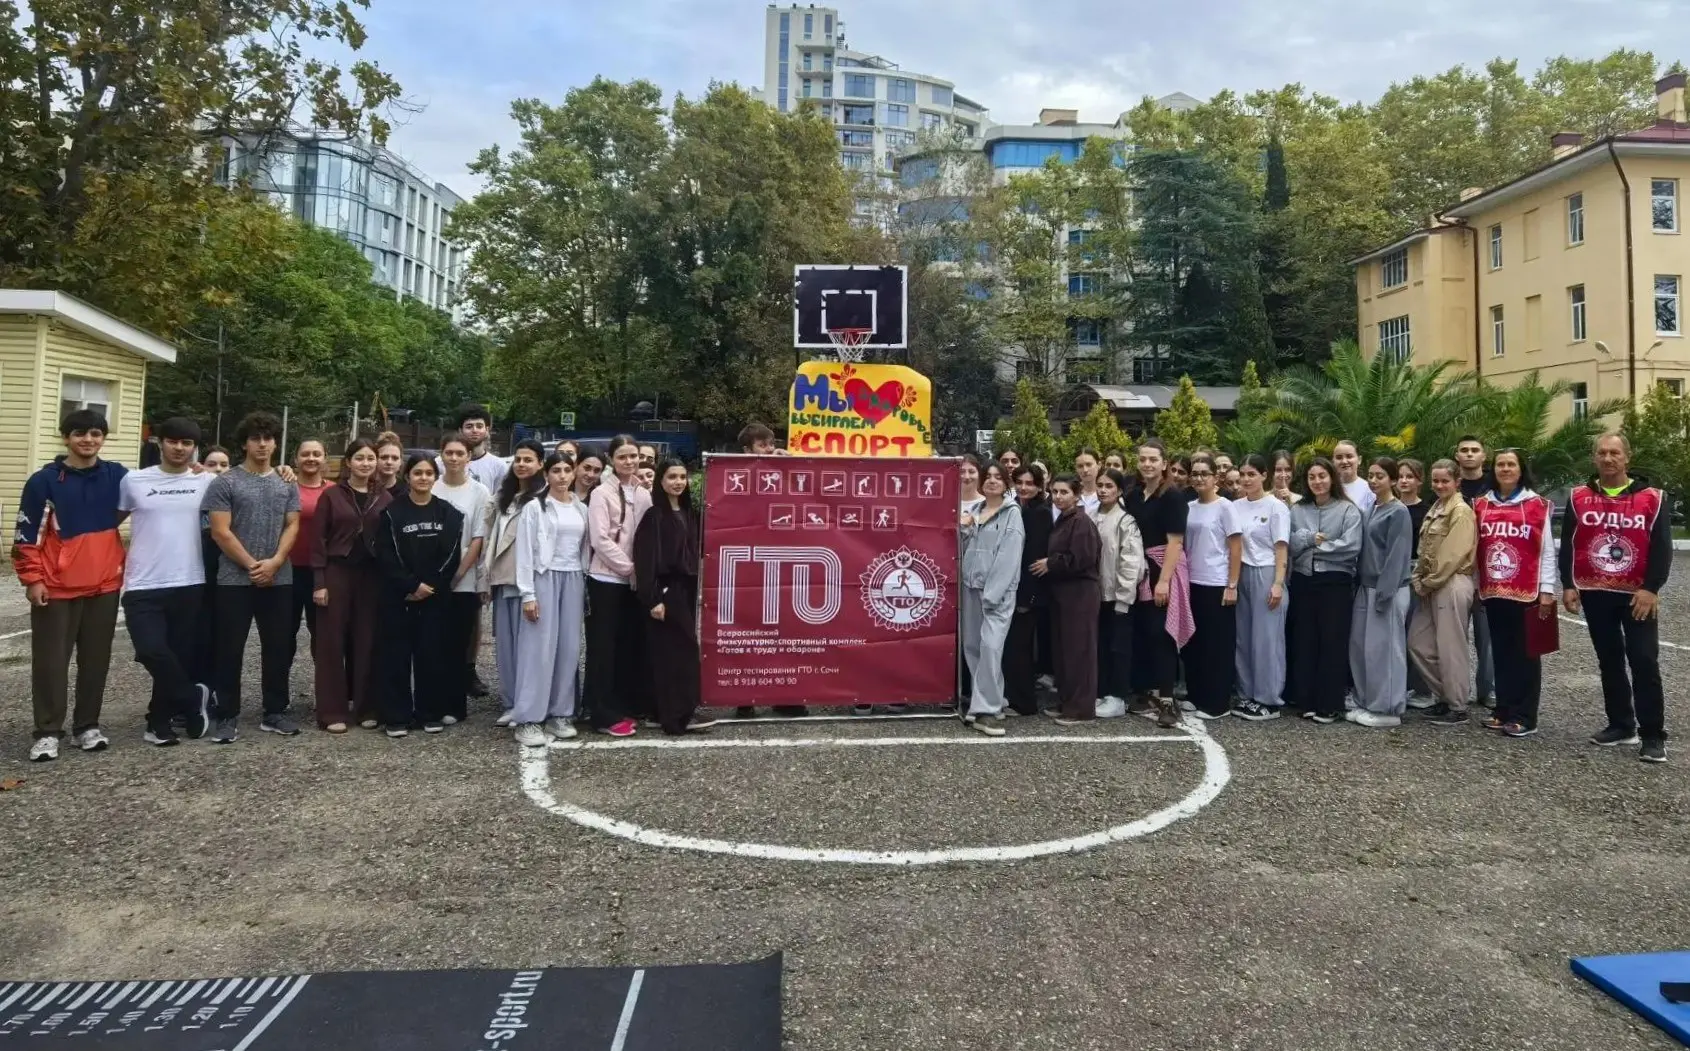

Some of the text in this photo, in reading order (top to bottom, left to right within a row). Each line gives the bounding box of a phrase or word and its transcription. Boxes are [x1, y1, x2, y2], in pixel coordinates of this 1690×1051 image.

[794, 374, 855, 412] Мы
[800, 432, 915, 457] СПОРТ
[1581, 511, 1646, 530] СУДЬЯ
[717, 545, 842, 625] ГТО
[892, 597, 915, 606] ГТО
[717, 629, 779, 638] Всероссийский
[829, 638, 867, 646] комплекс
[754, 647, 777, 655] труду
[718, 667, 741, 676] Центр
[743, 667, 796, 676] тестирования
[797, 666, 813, 674] ГТО
[820, 666, 839, 674] Сочи
[742, 678, 756, 686] 918
[759, 678, 773, 686] 604
[775, 677, 785, 685] 90
[787, 677, 797, 685] 90
[181, 1006, 219, 1031] 1.20
[476, 971, 544, 1051] -sport.ru
[67, 1012, 110, 1036] 1.50
